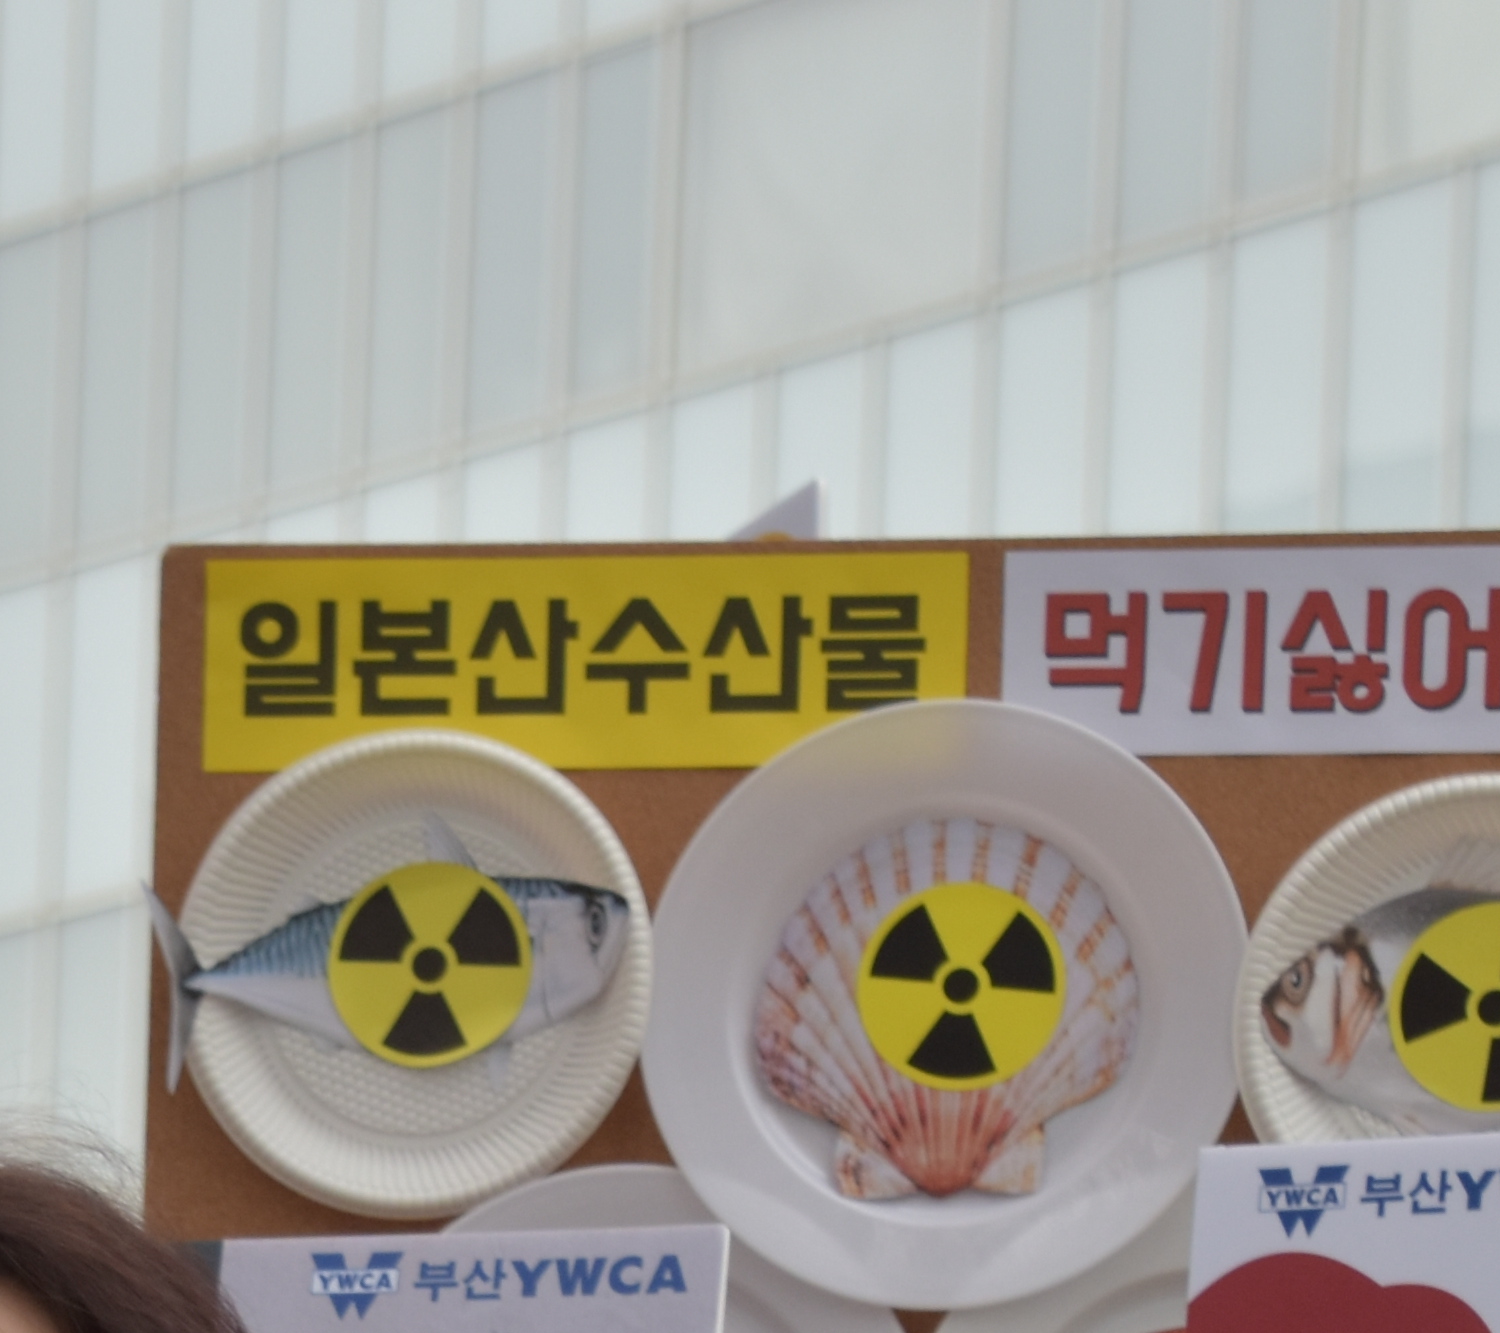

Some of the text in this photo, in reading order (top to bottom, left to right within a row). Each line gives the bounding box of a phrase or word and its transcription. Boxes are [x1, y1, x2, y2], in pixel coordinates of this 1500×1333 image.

[239, 594, 927, 719] 일본산수산물
[1265, 1186, 1340, 1209] YWCA
[318, 1254, 688, 1303] YWCA 부산YWCA
